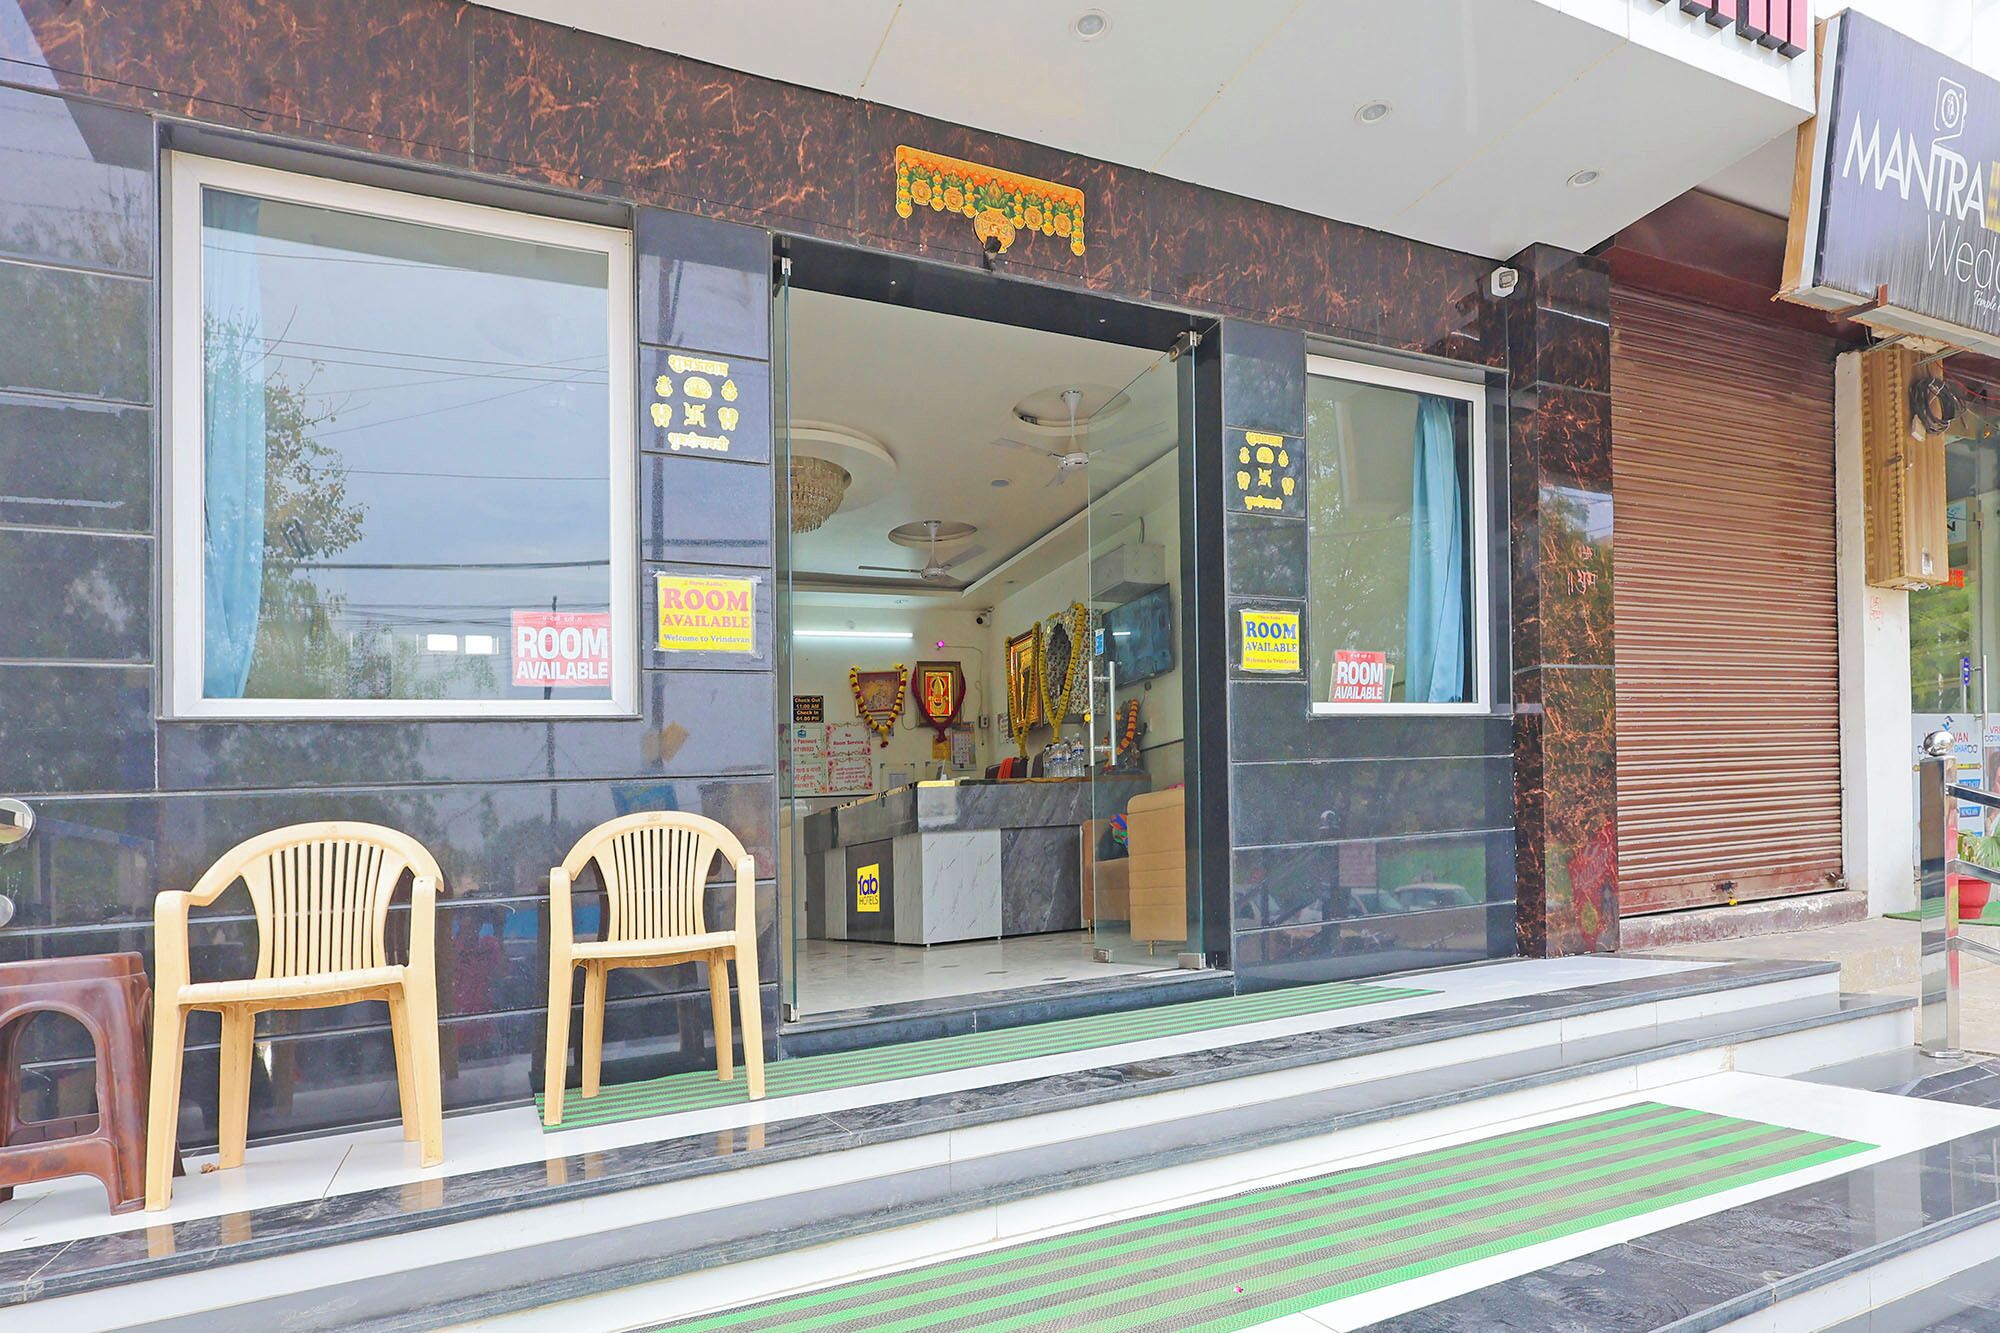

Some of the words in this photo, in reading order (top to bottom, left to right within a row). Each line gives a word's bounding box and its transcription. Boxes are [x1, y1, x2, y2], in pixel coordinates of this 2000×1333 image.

[1842, 111, 1985, 229] MANTRA
[663, 588, 749, 612] ROOM
[662, 613, 750, 628] AVAILABLE
[1245, 620, 1297, 640] ROOM
[517, 626, 608, 660] ROOM
[664, 633, 698, 642] Welcome
[711, 635, 751, 643] Vrindavan
[1245, 641, 1297, 653] AVAILABLE
[516, 660, 609, 680] AVAILABLE
[1336, 661, 1384, 685] ROOM
[1333, 685, 1384, 700] AVAILABLE
[858, 873, 879, 895] fab
[859, 895, 879, 905] HOTELS
